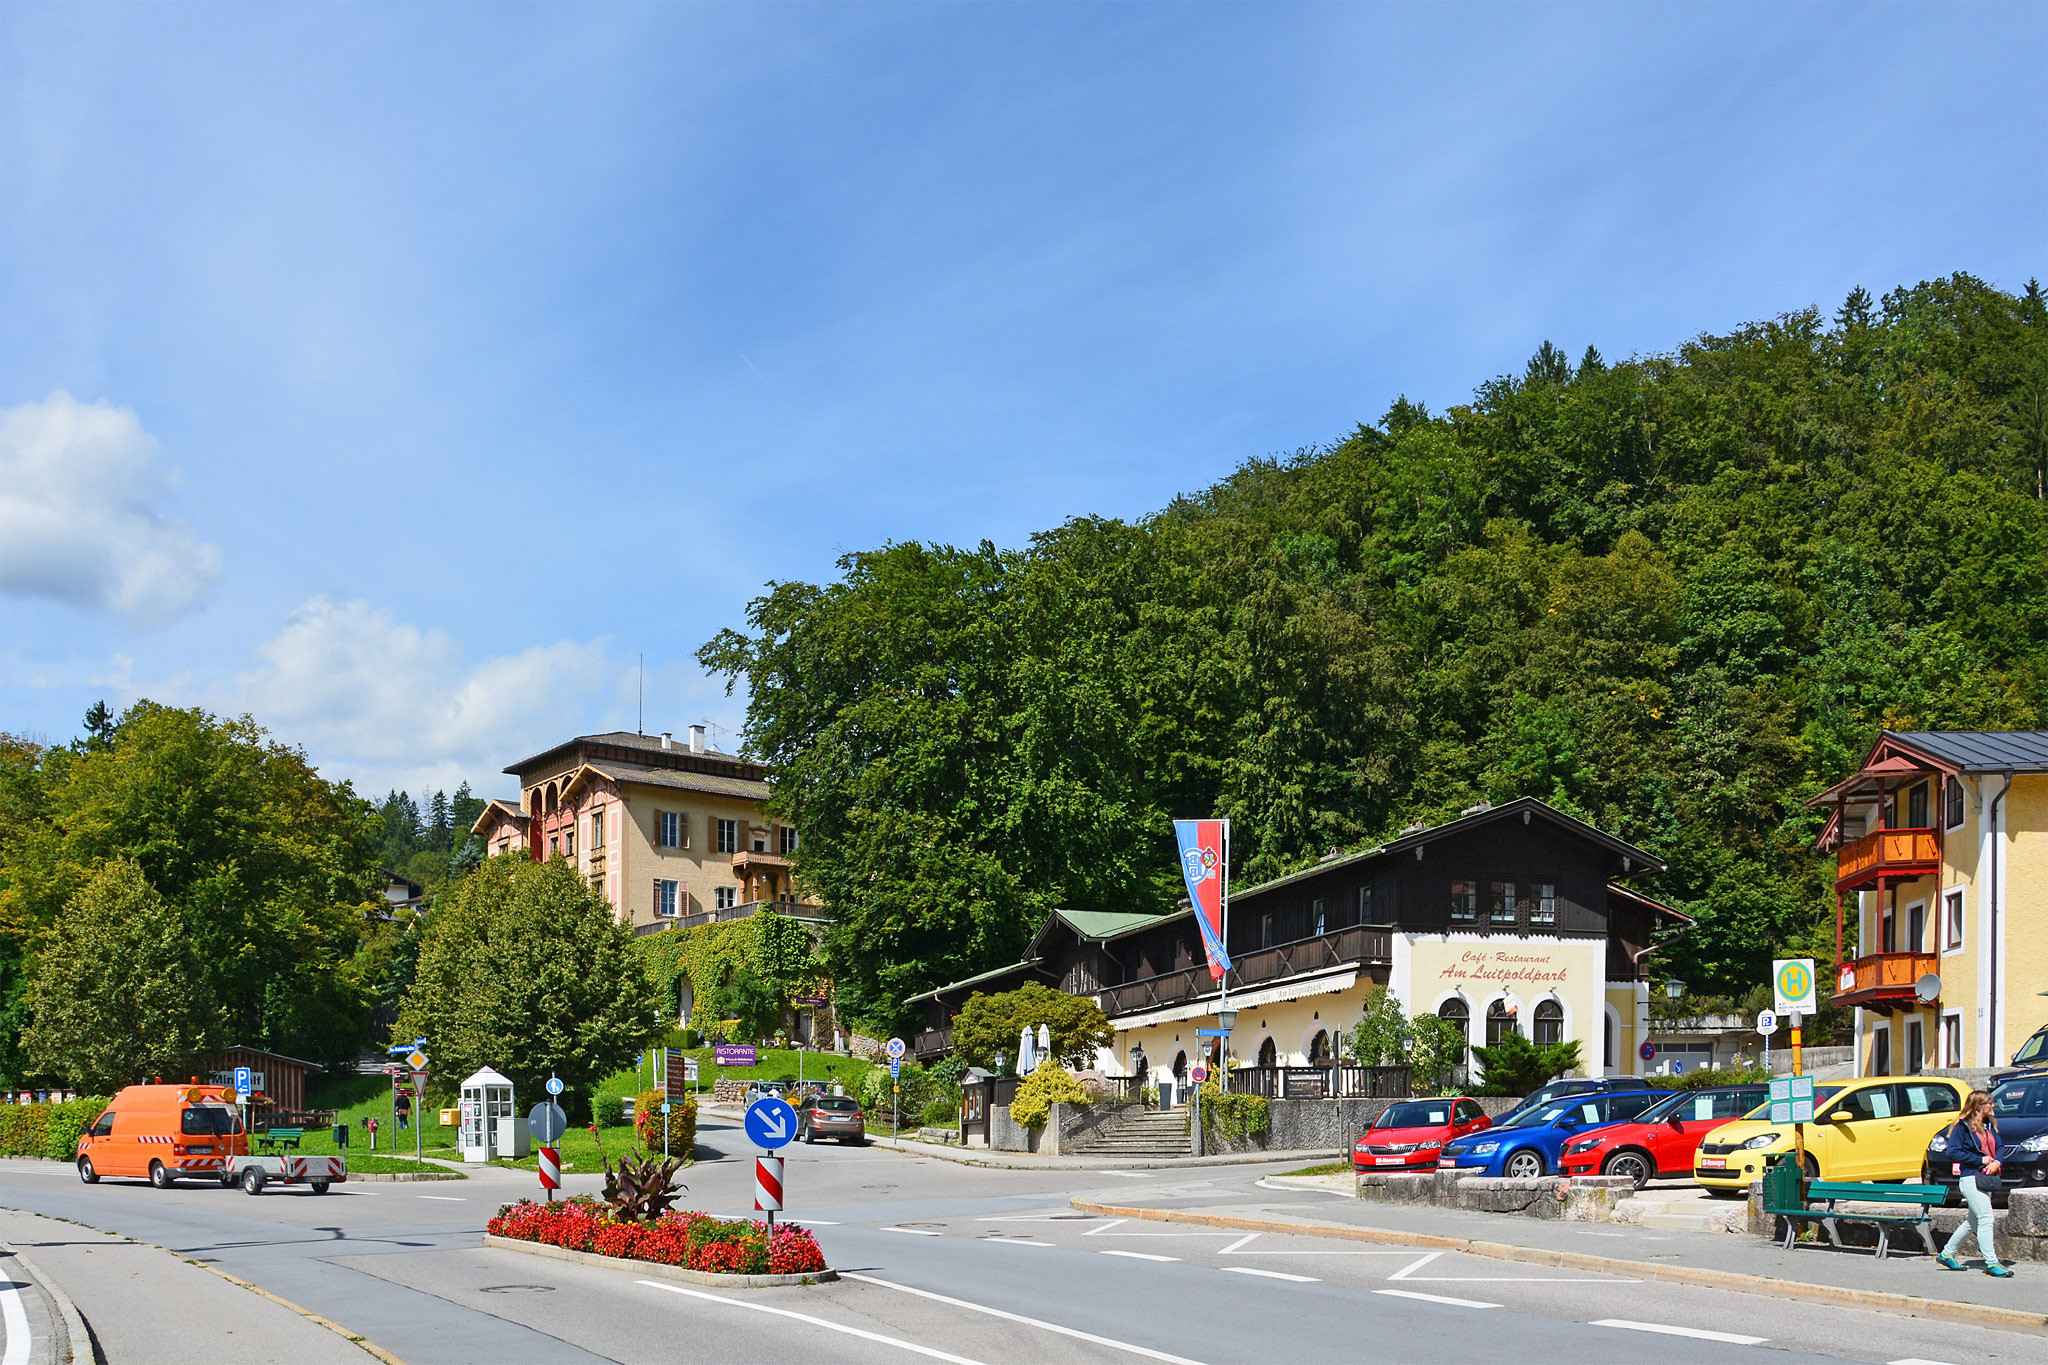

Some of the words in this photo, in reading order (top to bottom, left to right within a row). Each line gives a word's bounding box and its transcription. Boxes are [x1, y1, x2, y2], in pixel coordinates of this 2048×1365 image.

[1461, 950, 1487, 964] Café
[1495, 951, 1551, 964] Restaurant
[1439, 963, 1467, 979] Am
[1469, 964, 1567, 984] Luitpoldpark
[1786, 971, 1803, 992] H
[238, 1071, 247, 1086] P
